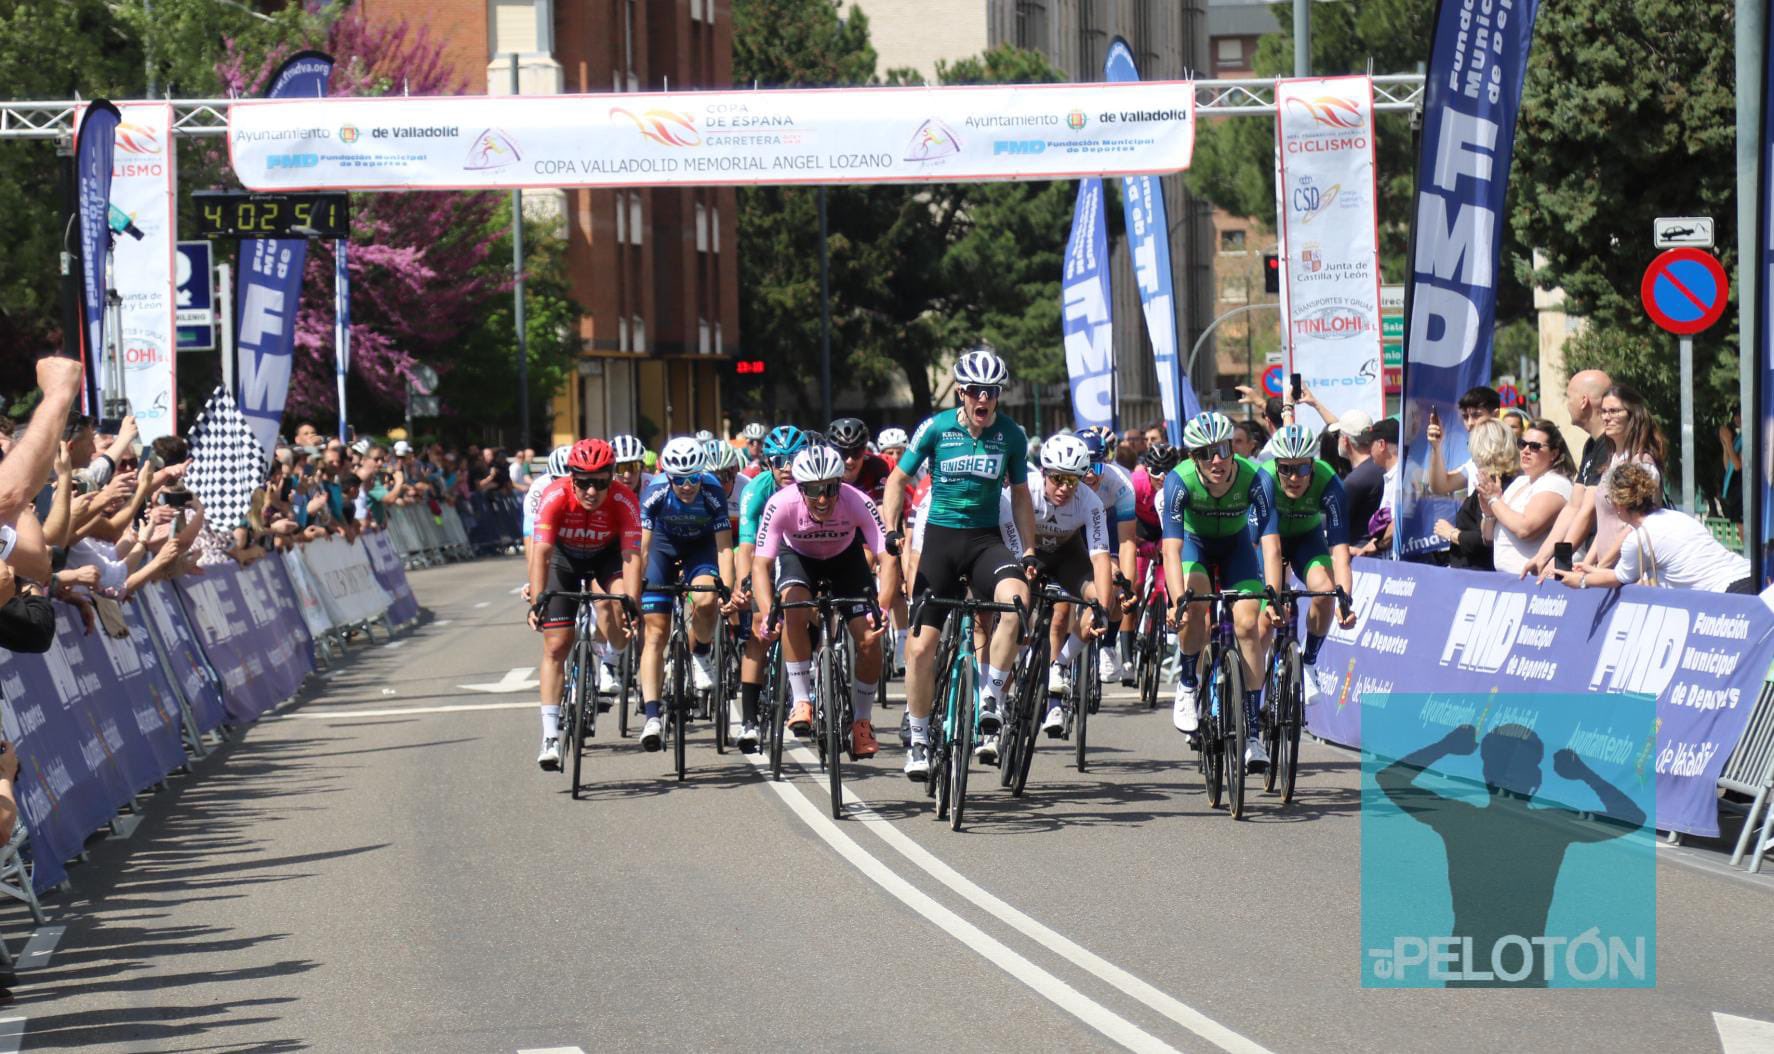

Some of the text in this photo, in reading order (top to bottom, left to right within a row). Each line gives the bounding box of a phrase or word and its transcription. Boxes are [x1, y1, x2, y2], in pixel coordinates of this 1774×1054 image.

[706, 104, 749, 114] COPA
[965, 109, 1187, 128] Ayuntamiento de Valladolid
[706, 116, 726, 127] DE
[236, 126, 459, 142] Ayuntamiento de Valladolid
[706, 135, 781, 146] CARRETERA
[993, 140, 1046, 155] FMD
[1287, 137, 1367, 153] CICLISMO
[113, 165, 162, 177] LISMO
[534, 153, 893, 174] COPA VALLADOLID MEMORIAL ANGEL LOZANO
[1293, 186, 1320, 212] CSD
[1297, 270, 1368, 282] Castilla y León
[1325, 262, 1368, 272] Junta de
[1294, 297, 1342, 316] TRANSPORTES
[1293, 316, 1363, 334] TINLOHI
[127, 347, 156, 363] OHI
[941, 456, 998, 475] FINISHER
[757, 504, 777, 547] GOMUR
[1370, 602, 1408, 627] Municipal
[1439, 587, 1527, 674] FMD
[1693, 612, 1750, 640] Fundación
[1361, 629, 1408, 656] de Deportes
[1588, 602, 1690, 701] FMD
[1506, 654, 1557, 681] de Deportes
[1681, 646, 1740, 679] Municipal
[1670, 682, 1685, 706] de
